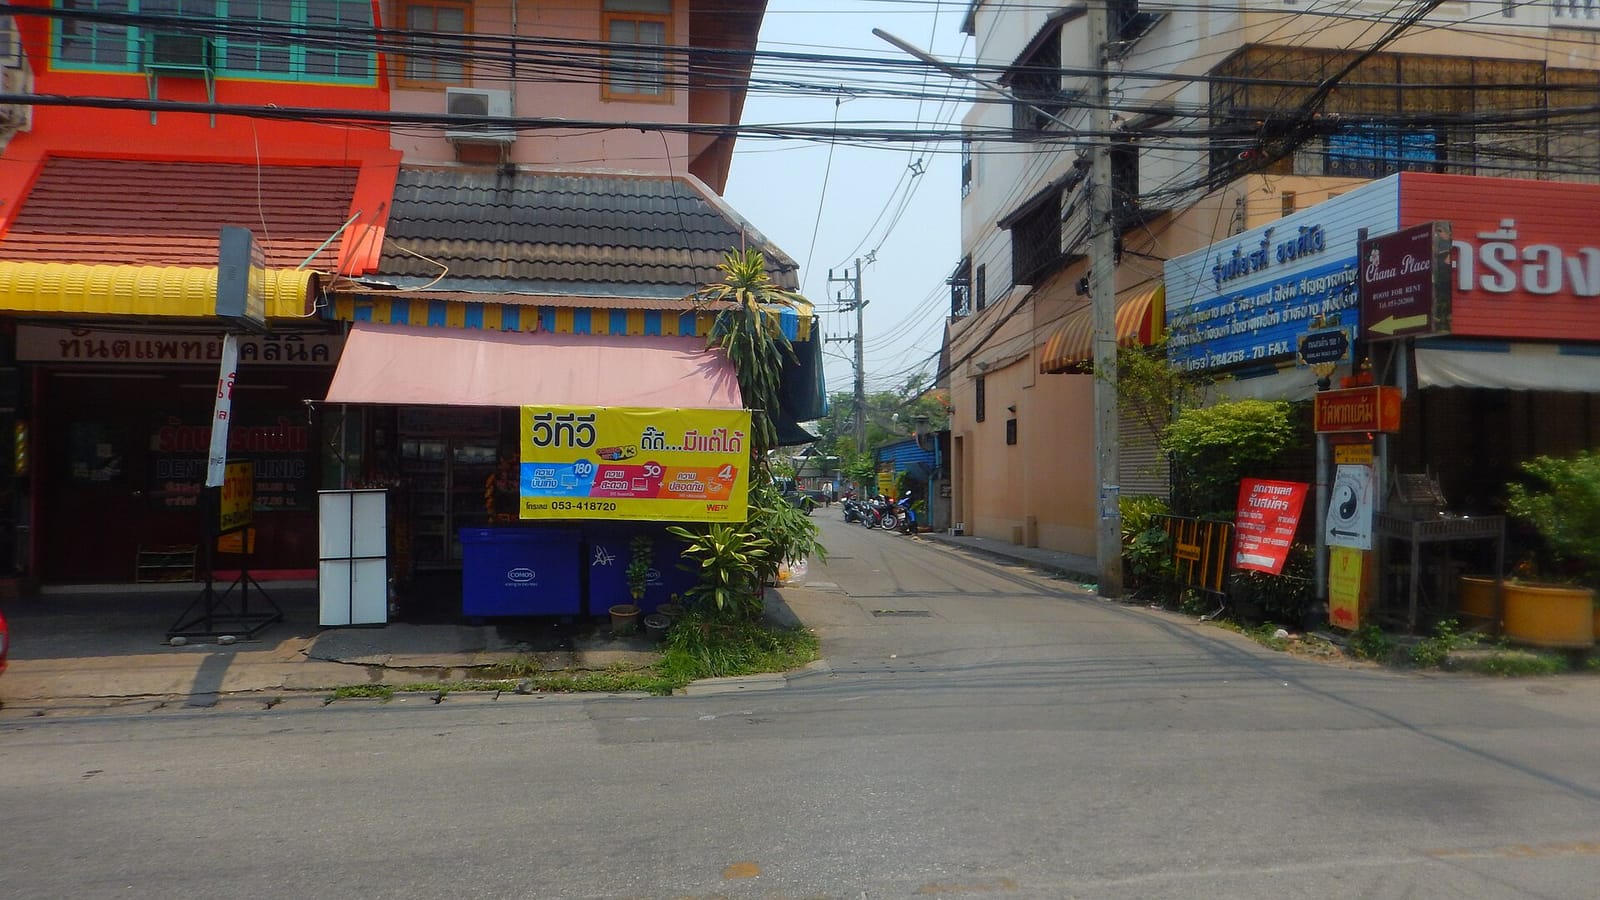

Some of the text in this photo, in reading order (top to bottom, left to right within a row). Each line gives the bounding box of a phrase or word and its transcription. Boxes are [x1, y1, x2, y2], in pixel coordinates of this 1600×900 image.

[1451, 218, 1600, 297] ครื่อง
[1365, 254, 1431, 283] Chana Place
[1373, 284, 1422, 301] ROOM FOR RENT
[1210, 349, 1245, 367] 284268
[1252, 345, 1265, 359] 70
[1268, 340, 1290, 356] FAX
[532, 411, 597, 448] วีทีวี
[255, 458, 306, 479] LINIC
[534, 468, 555, 477] ความ
[574, 463, 592, 474] 180
[604, 470, 624, 479] ความ
[642, 464, 662, 477] 30
[718, 464, 733, 479] 4
[531, 476, 558, 489] บันเทิง
[677, 471, 697, 481] ความ
[600, 480, 629, 491] สะดวก
[668, 480, 705, 494] ปลอดภัย
[551, 501, 617, 512] 053-418720
[1248, 493, 1289, 511] รับสมัคร
